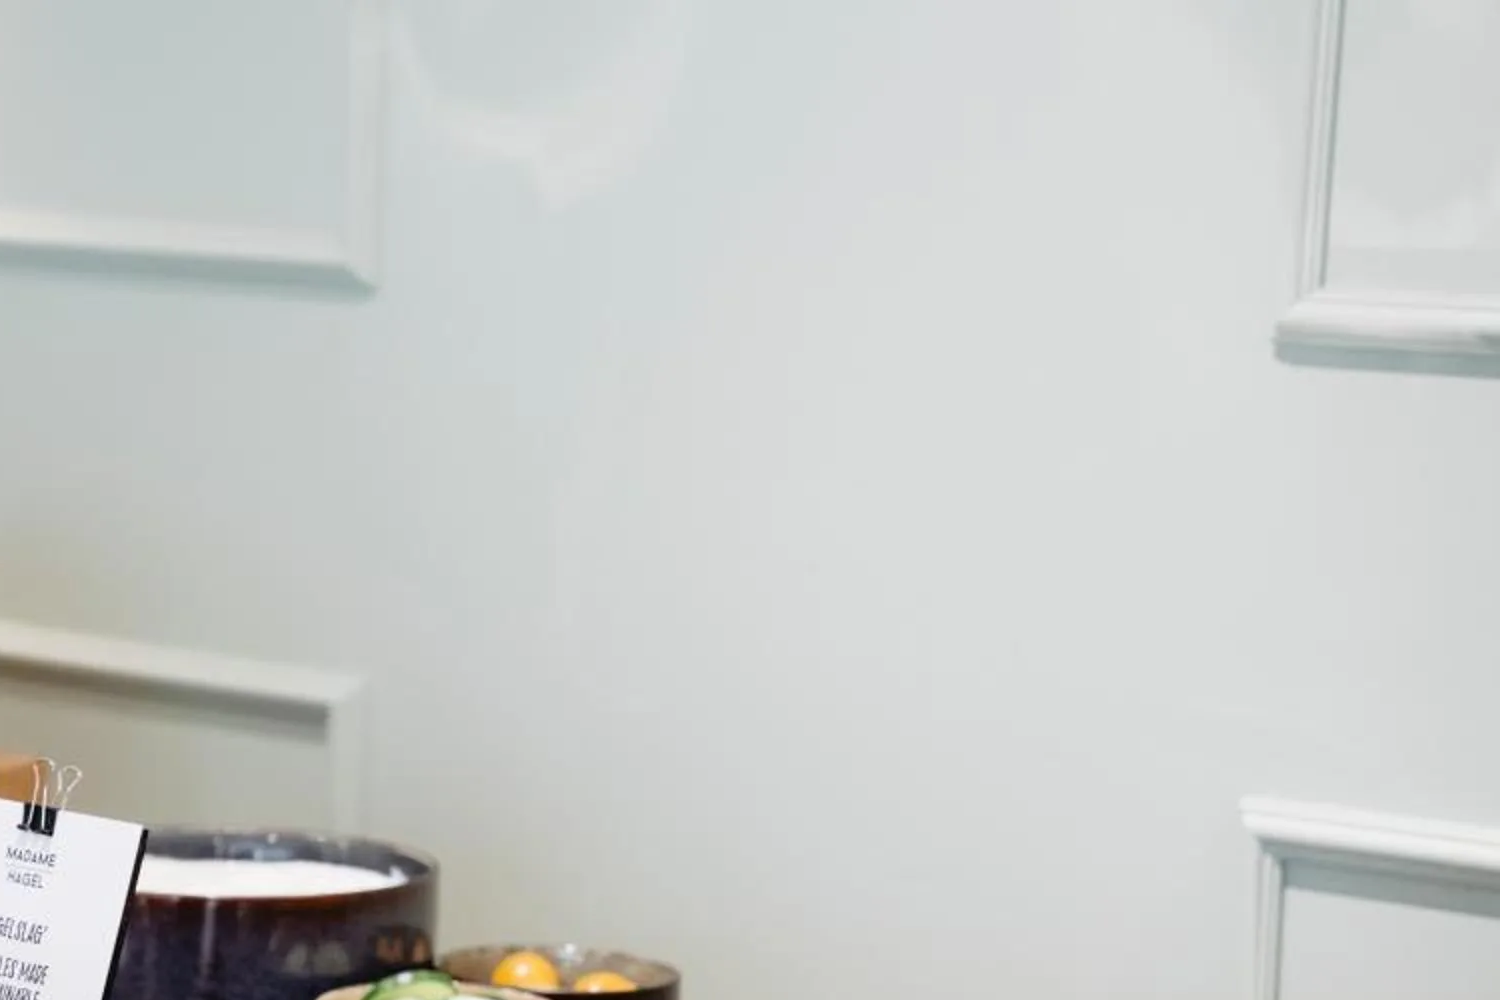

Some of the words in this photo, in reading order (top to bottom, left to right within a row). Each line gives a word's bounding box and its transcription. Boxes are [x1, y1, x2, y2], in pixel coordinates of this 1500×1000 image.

[6, 847, 57, 867] MADAME
[7, 872, 44, 889] HAGEL
[18, 963, 49, 985] MADE
